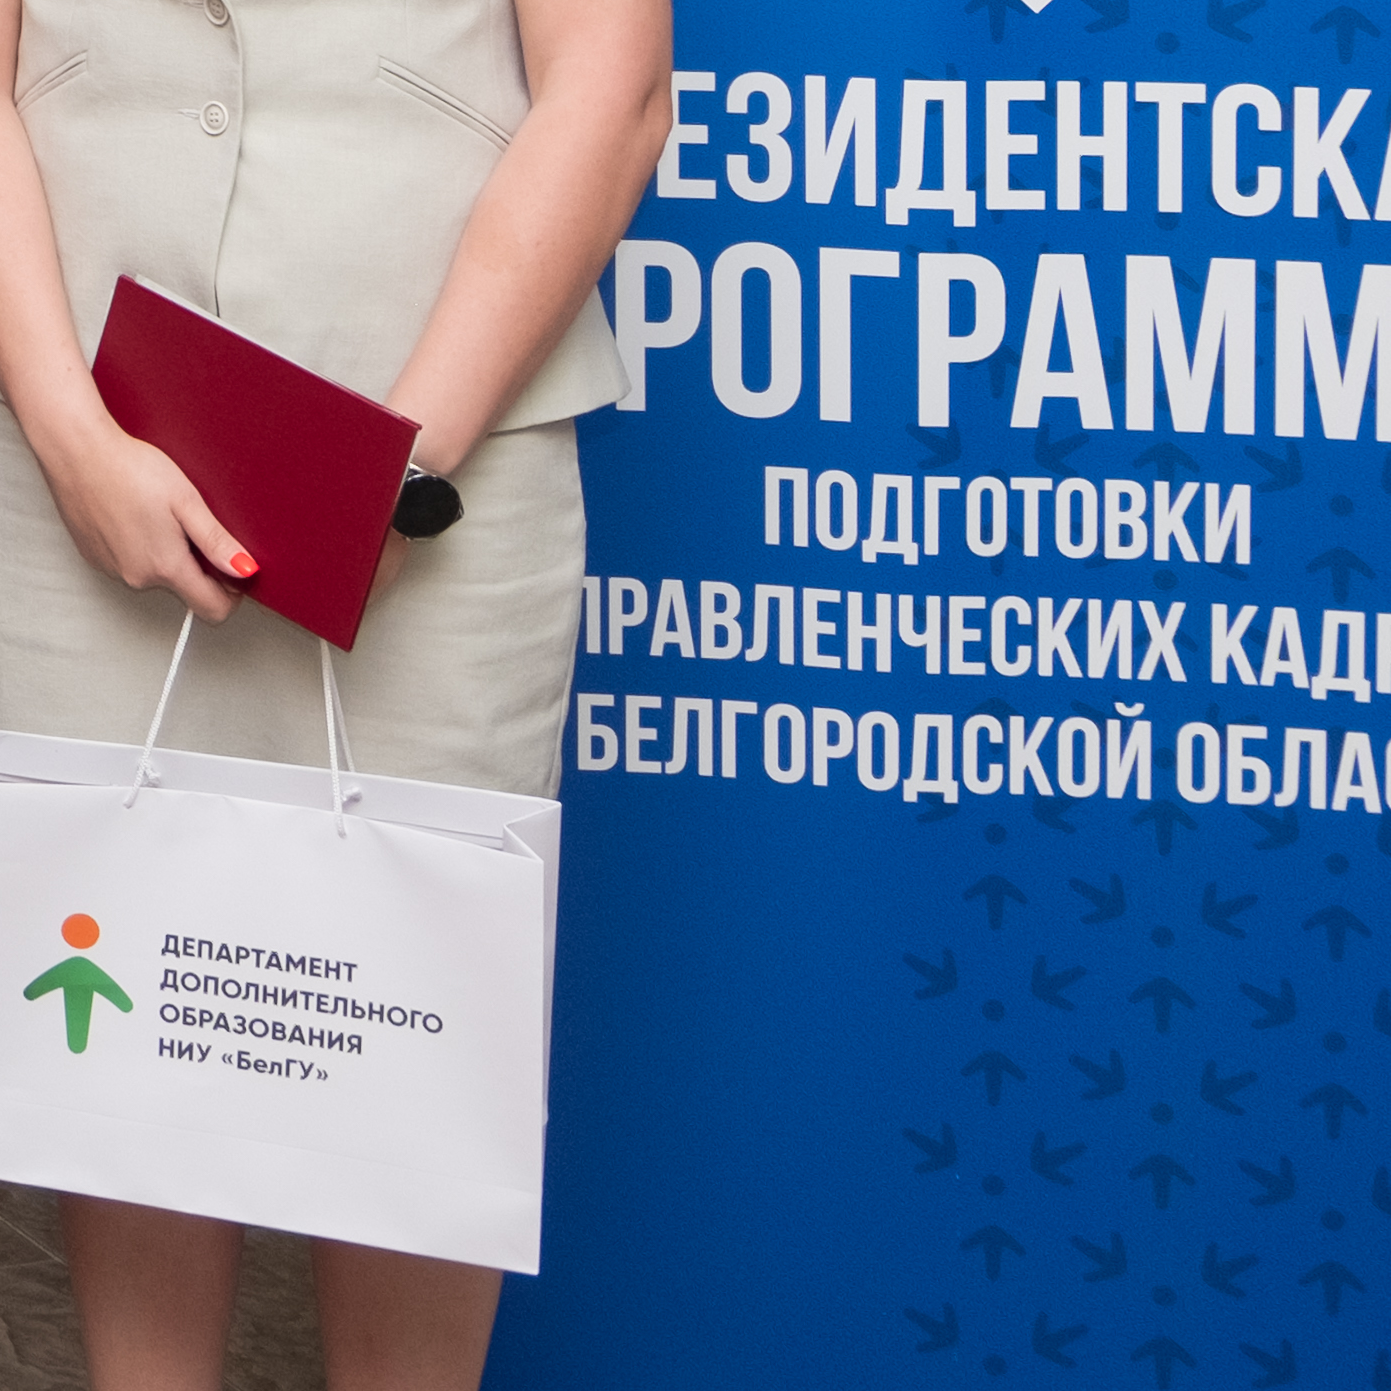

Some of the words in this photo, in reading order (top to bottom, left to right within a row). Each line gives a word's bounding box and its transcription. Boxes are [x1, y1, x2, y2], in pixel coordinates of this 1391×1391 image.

[657, 71, 1391, 227] ЕЗИДЕНТСК
[763, 466, 1253, 566] ПОДГОТОВКИ
[577, 693, 1156, 804] БЕЛГОРОДСКОЙ
[1177, 721, 1391, 815] ОБЛА
[161, 934, 358, 983] ДЕПАРТАМЕНТ
[159, 1003, 364, 1055] ОБРАЗОВАНИЯ
[160, 969, 444, 1035] ДОПОЛНИТЕЛЬНОГО
[158, 1037, 212, 1064] НИУ
[221, 1049, 329, 1082] «БелГУ»
